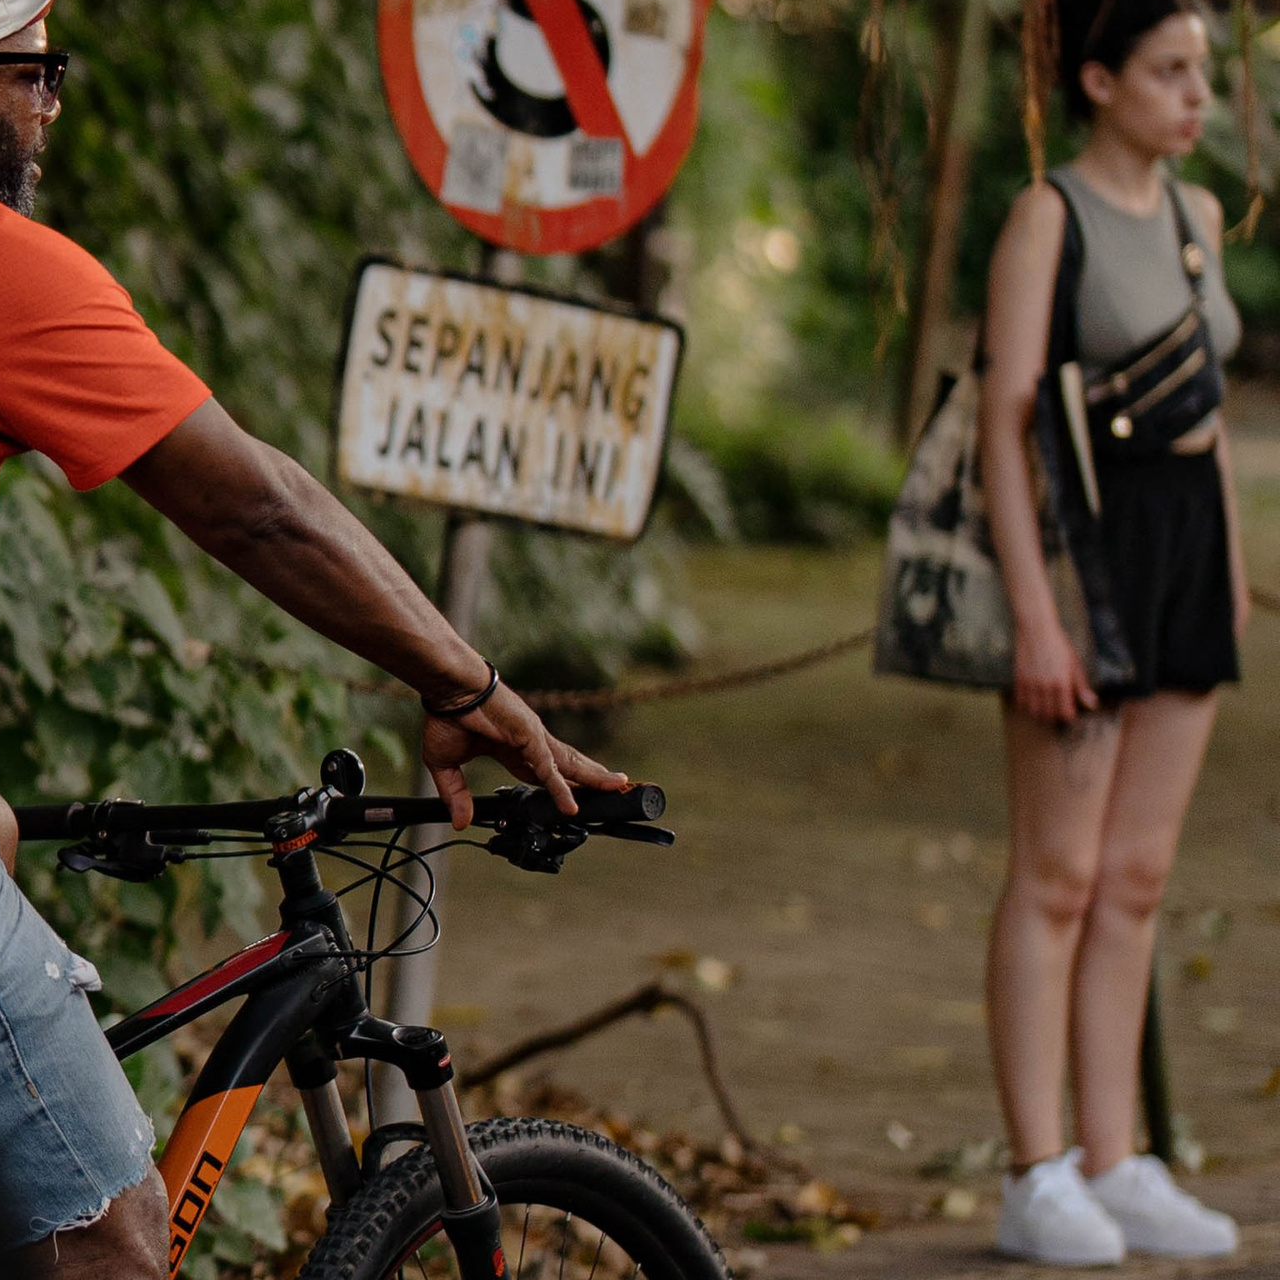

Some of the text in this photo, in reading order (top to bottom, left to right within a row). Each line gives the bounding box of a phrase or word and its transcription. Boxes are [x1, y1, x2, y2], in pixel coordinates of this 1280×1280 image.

[371, 308, 651, 427] SEPANJANG
[376, 398, 621, 504] JALAN INI
